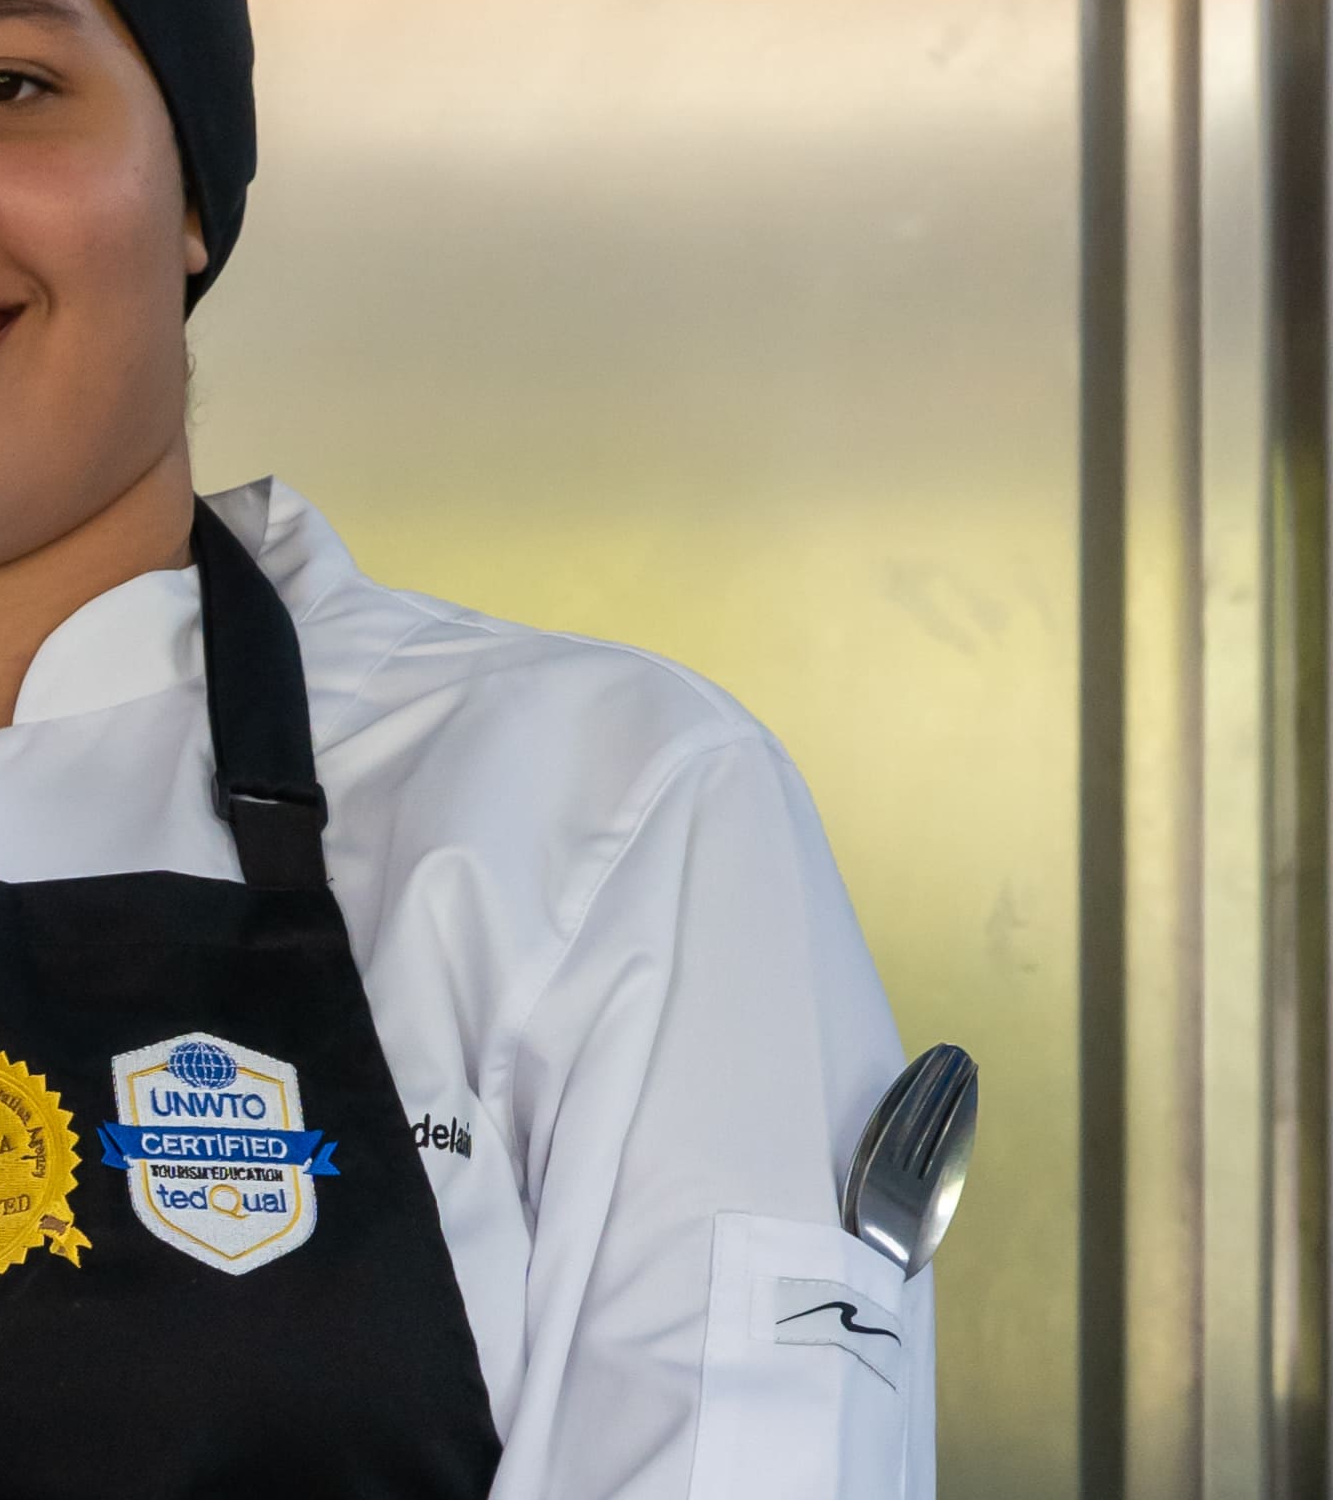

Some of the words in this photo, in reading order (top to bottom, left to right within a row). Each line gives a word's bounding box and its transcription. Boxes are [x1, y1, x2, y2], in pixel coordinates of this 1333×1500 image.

[150, 1087, 266, 1120] UNWTO
[141, 1133, 289, 1160] CERTIFIED
[156, 1183, 288, 1220] tedQual
